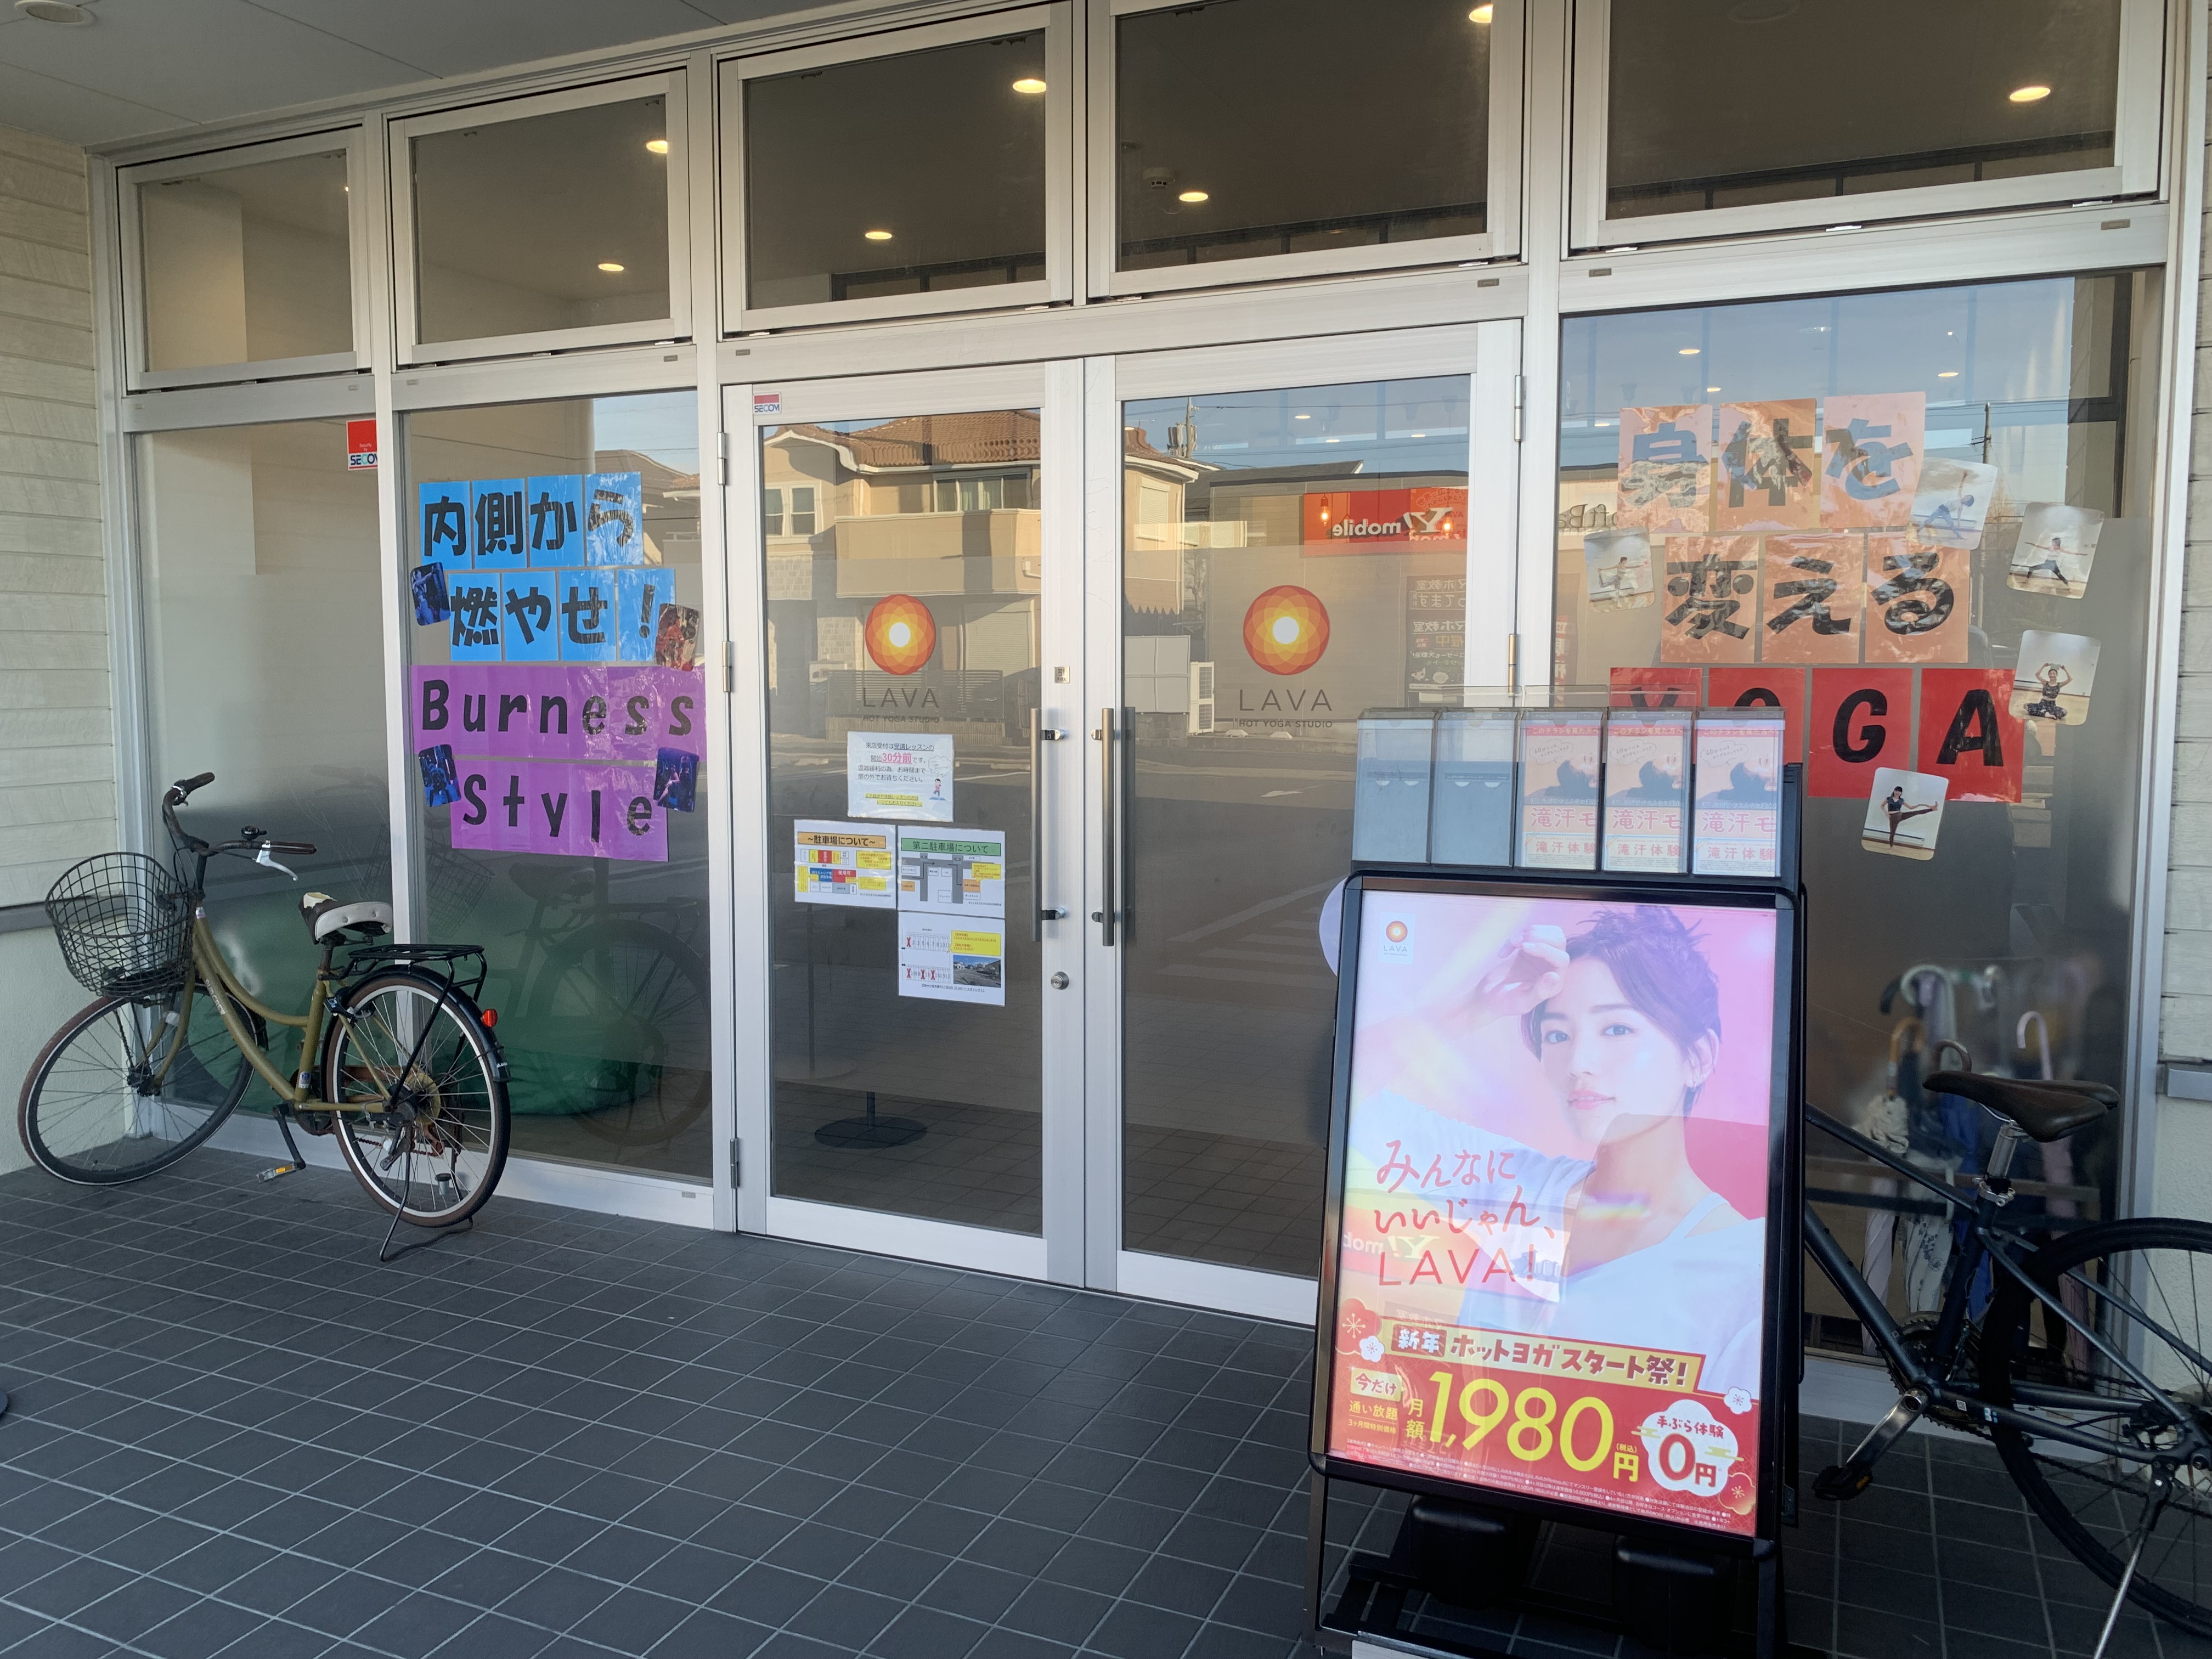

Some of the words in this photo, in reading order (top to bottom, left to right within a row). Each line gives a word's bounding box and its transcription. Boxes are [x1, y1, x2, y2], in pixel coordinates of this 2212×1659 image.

[754, 404, 780, 413] SECOM
[1621, 417, 1916, 508] 身体を
[424, 489, 635, 557] 内側から
[450, 583, 656, 647] 燃やせ!
[1665, 550, 1955, 640] 変える
[422, 680, 694, 736] Burness
[863, 687, 939, 708] LAVA
[1240, 689, 1332, 711] LAVA
[866, 742, 934, 751] 来店受付は受講レッスンの
[1629, 687, 2004, 766] GA
[871, 752, 926, 764] 開始30分前です。
[463, 774, 651, 843] Style
[913, 840, 989, 853] 第二駐車場について
[1376, 1139, 1516, 1193] みんなに
[1374, 1184, 1555, 1239] いいじゃん、
[1379, 1243, 1534, 1286] LAVA!
[1398, 1329, 1440, 1353] 新年
[1450, 1334, 1688, 1386] ホットヨガスタート祭!
[1355, 1372, 1397, 1396] 今だけ
[1348, 1419, 1397, 1435] 3ヶ月間特別価格
[1349, 1400, 1398, 1421] 通い放題
[1406, 1398, 1425, 1440] 月額
[1657, 1415, 1724, 1439] 手ぶら体験
[1616, 1443, 1637, 1454] (税込)
[1658, 1433, 1717, 1488] 0円
